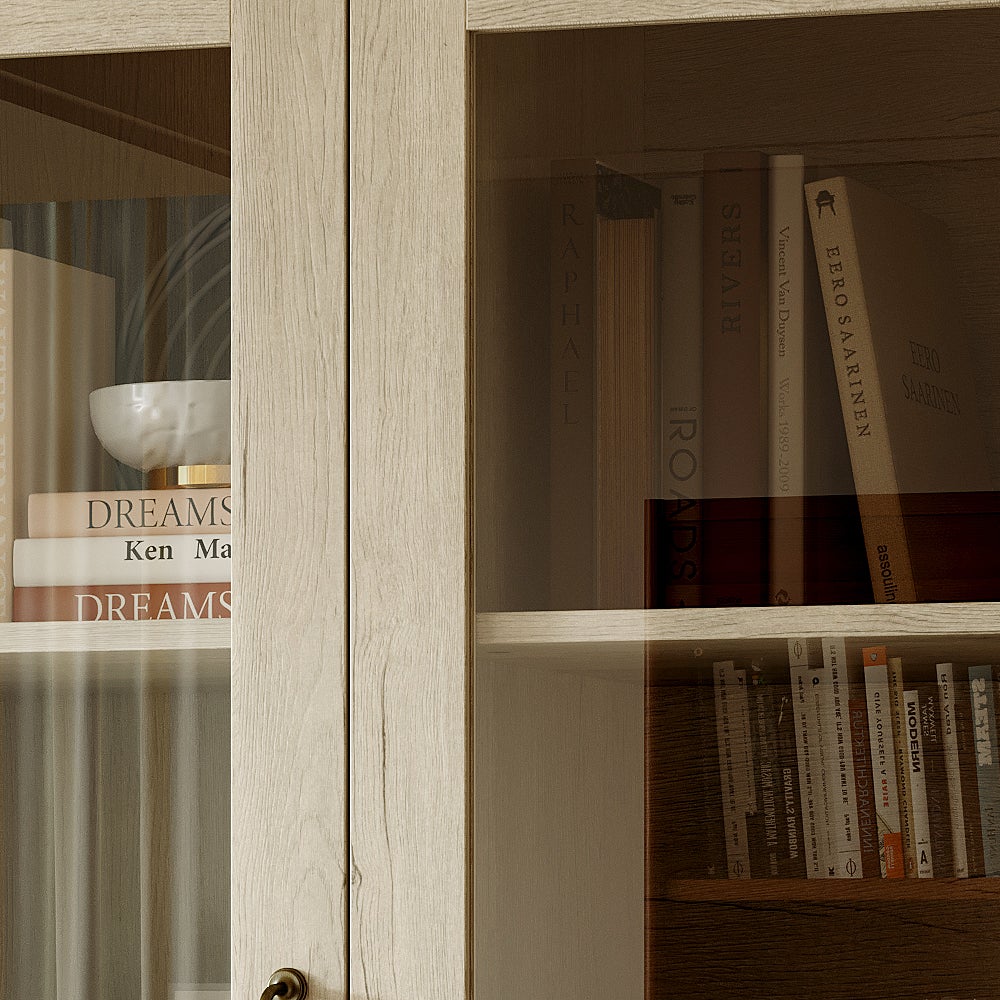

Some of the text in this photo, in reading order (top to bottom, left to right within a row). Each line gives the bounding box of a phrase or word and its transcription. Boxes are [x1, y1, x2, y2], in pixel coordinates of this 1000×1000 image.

[720, 203, 743, 336] RIVERS
[778, 226, 791, 276] Vincent
[560, 202, 586, 427] RAPHAEL
[778, 280, 790, 307] Van
[775, 309, 790, 357] Duysen
[826, 246, 872, 438] EERO SAARINEN
[909, 341, 941, 373] EERO
[779, 378, 790, 417] Works
[902, 374, 961, 416] SAARINEN
[668, 419, 699, 583] ROADS
[124, 540, 174, 561] Ken
